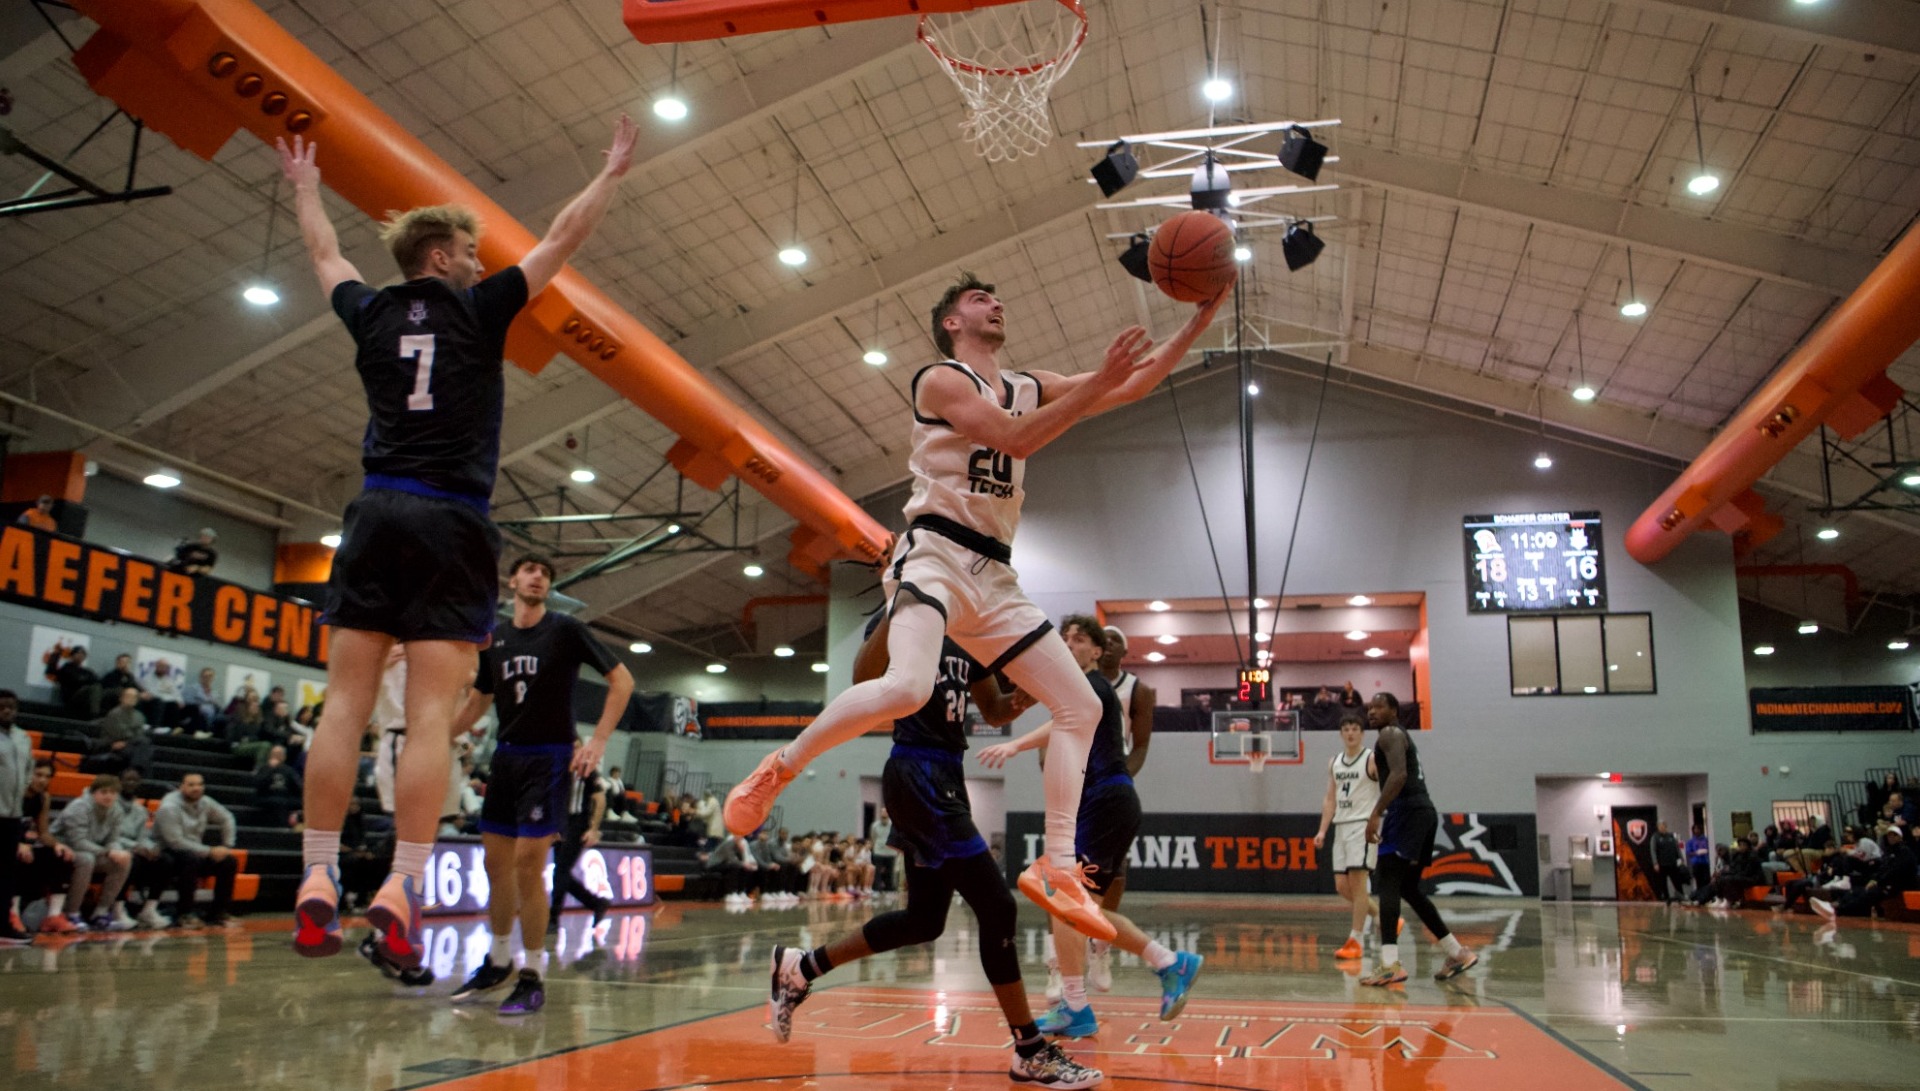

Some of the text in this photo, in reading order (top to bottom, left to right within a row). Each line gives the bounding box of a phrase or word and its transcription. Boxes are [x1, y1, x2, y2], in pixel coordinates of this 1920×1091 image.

[400, 333, 435, 411] 7
[1511, 531, 1557, 549] 11:09
[0, 526, 195, 633] AEFER
[1476, 559, 1507, 582] 18
[1566, 556, 1597, 580] 16
[502, 655, 538, 680] LTU
[1342, 782, 1351, 797] 4
[1023, 834, 1318, 870] IANA TECH
[424, 852, 462, 907] 16
[617, 856, 647, 900] 18
